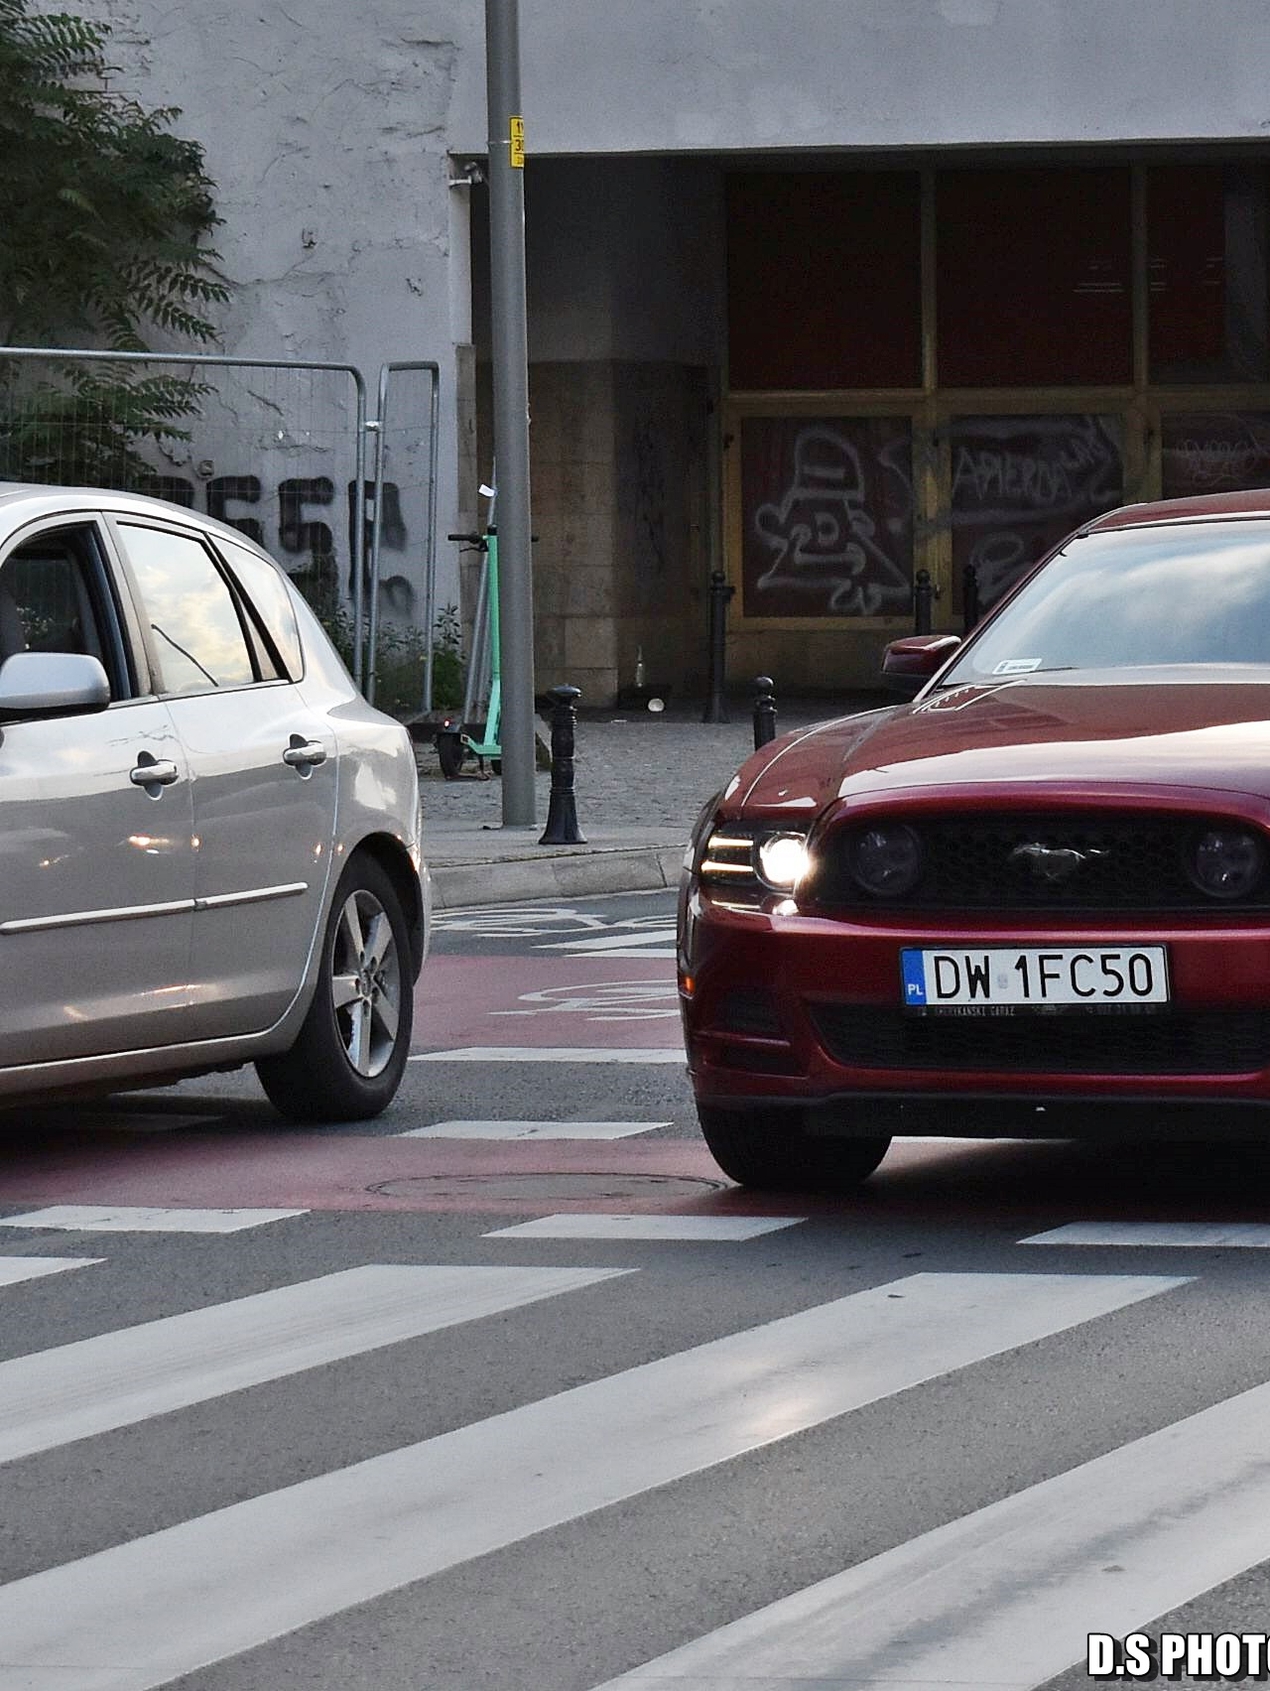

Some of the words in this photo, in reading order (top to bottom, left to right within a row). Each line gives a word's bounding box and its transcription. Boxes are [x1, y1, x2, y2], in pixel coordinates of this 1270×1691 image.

[908, 984, 923, 996] PL
[934, 955, 990, 999] DW
[1014, 953, 1153, 998] 1FC50
